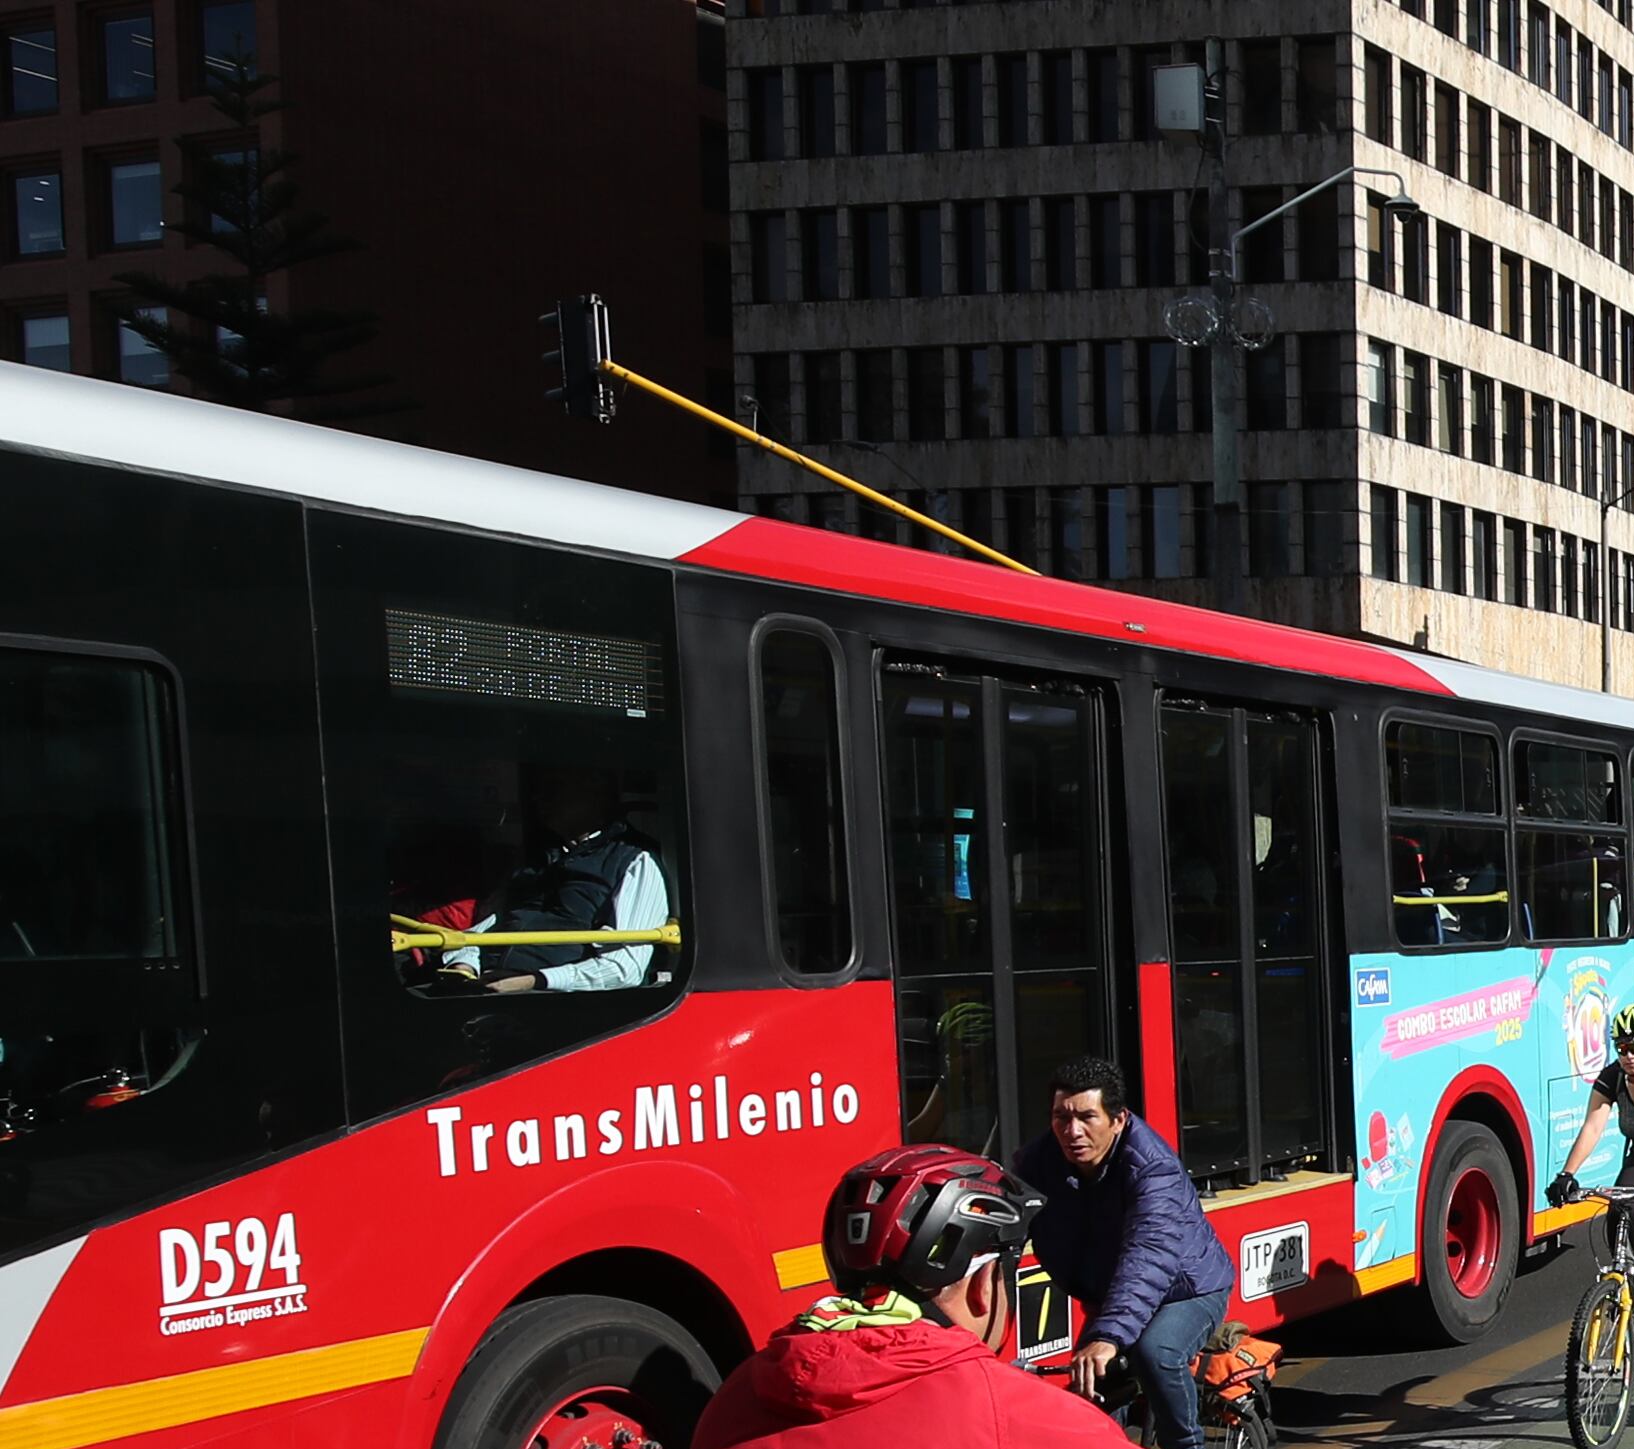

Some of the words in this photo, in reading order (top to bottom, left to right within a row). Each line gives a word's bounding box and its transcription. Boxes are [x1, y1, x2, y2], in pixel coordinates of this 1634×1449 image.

[1396, 1011, 1436, 1041] COMBO
[1439, 998, 1488, 1030] ESCOLAR
[1489, 990, 1522, 1014] CAFAM
[1494, 1017, 1523, 1046] 2025
[426, 1071, 860, 1177] TransMilenio
[159, 1212, 302, 1305] D594
[1245, 1242, 1273, 1273] JTP
[160, 1310, 224, 1336] Consorcio
[225, 1304, 273, 1327] Express
[274, 1294, 308, 1317] S.A.S.
[1020, 1336, 1070, 1360] TRANSMILENIO
